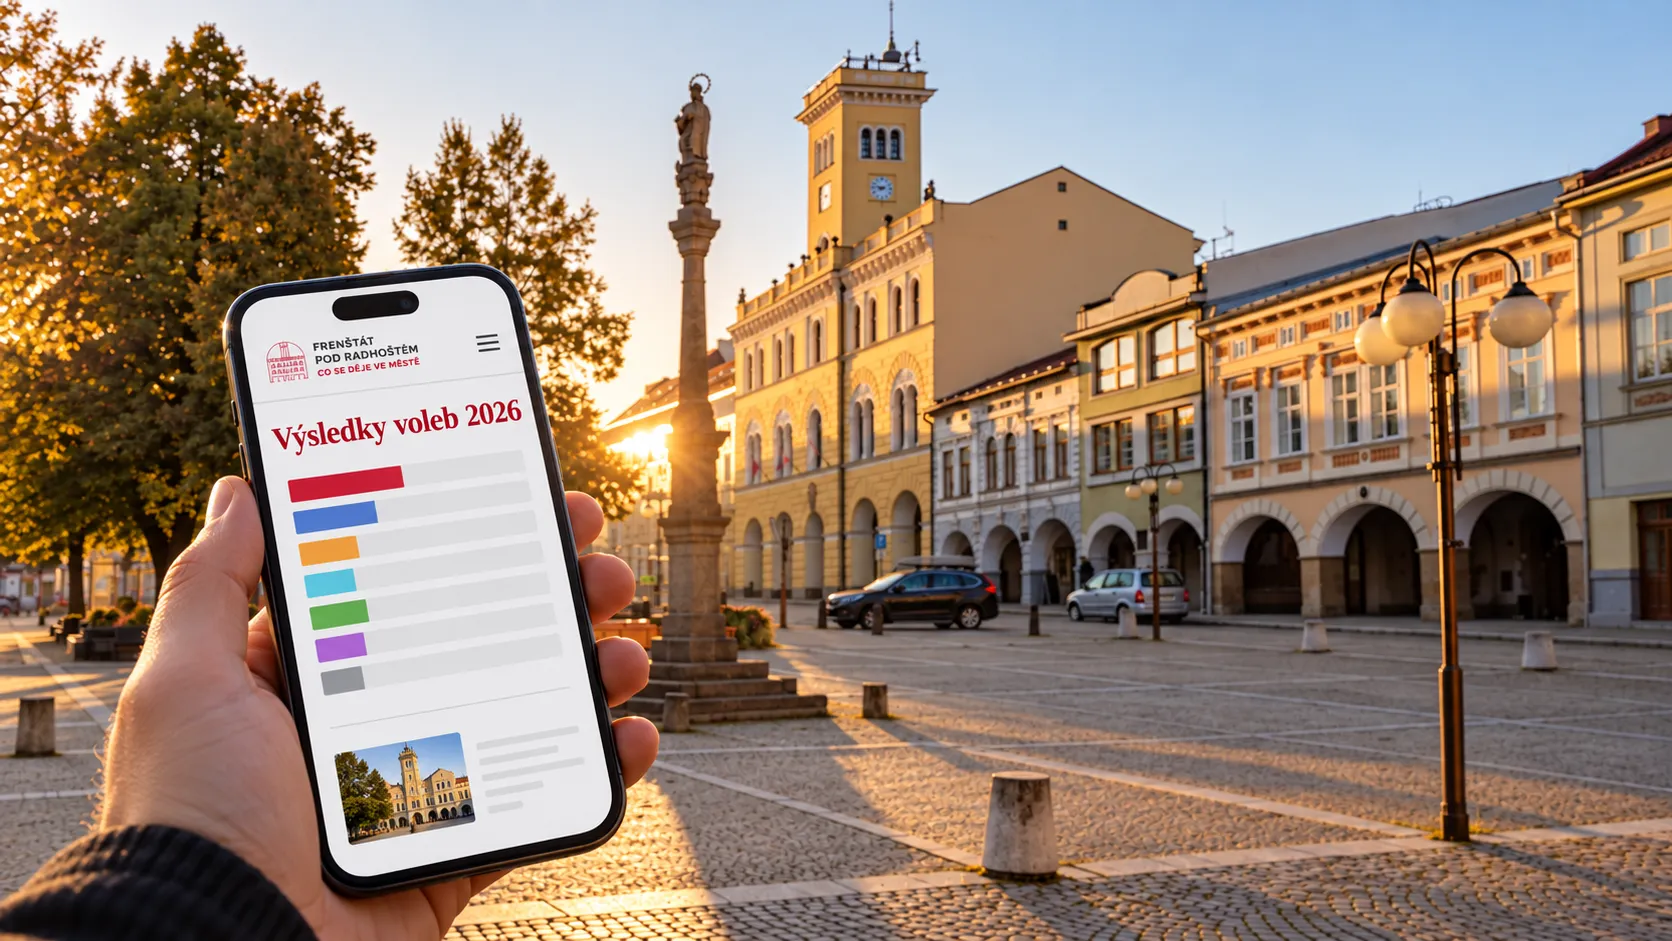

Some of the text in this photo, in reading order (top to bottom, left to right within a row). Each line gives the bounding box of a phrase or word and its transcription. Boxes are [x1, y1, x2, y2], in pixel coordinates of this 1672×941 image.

[313, 335, 374, 351] FRENŠTÁT
[315, 353, 341, 365] POD
[317, 368, 332, 377] CO
[334, 366, 347, 375] SE
[373, 362, 387, 370] VE
[271, 399, 523, 456] Výsledky voleb 2026
